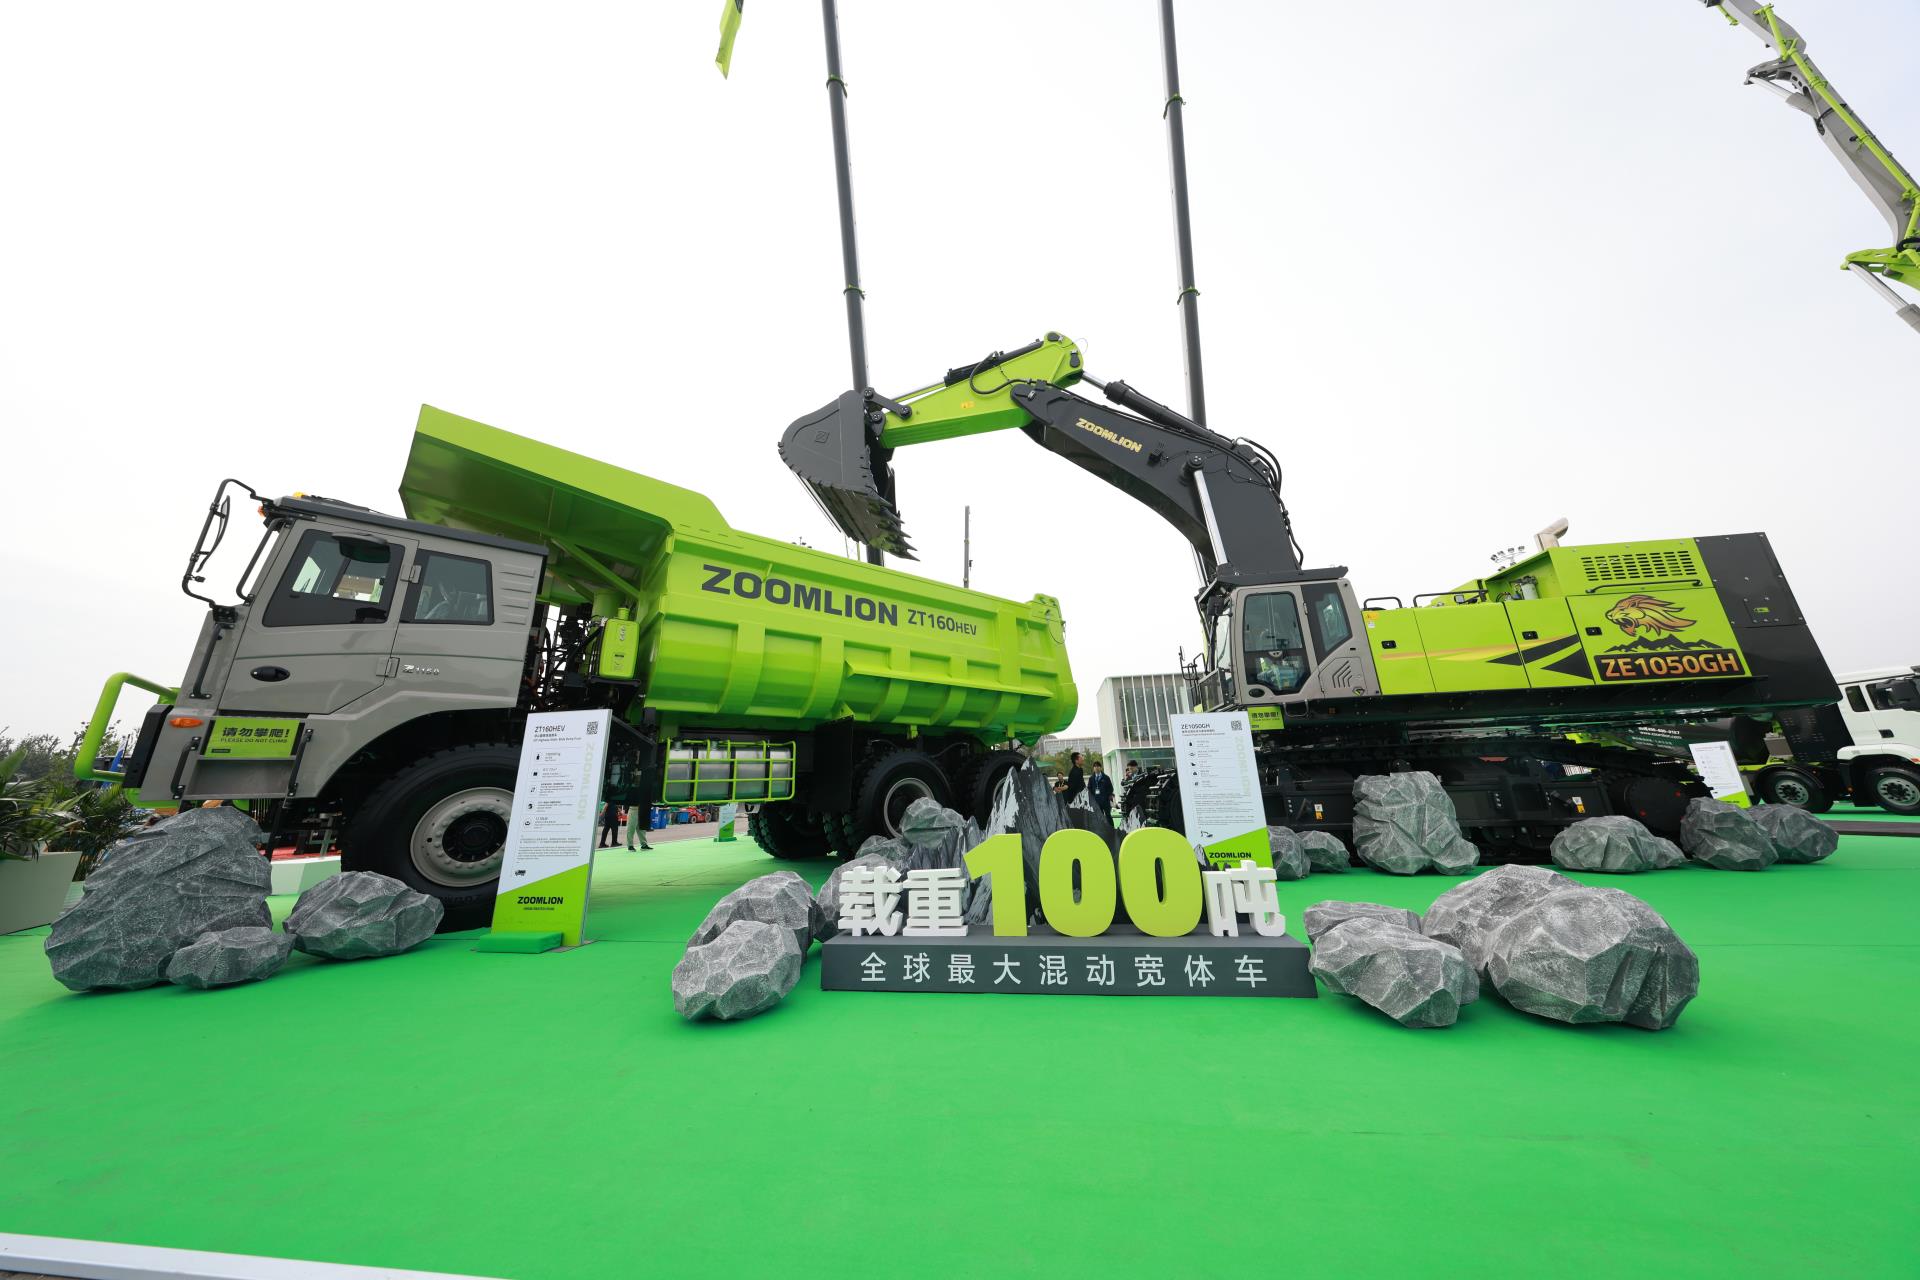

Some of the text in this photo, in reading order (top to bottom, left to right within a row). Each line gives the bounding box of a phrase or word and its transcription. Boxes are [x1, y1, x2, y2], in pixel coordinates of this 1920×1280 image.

[1075, 417, 1143, 453] ZOOMLION
[701, 564, 977, 636] ZOOMLION ZT160HEV
[1601, 653, 1739, 677] ZE1050GH
[534, 725, 566, 733] ZT160HEV
[517, 896, 563, 905] ZOOMLION
[860, 952, 1268, 987] 全球最大混动宽体车
